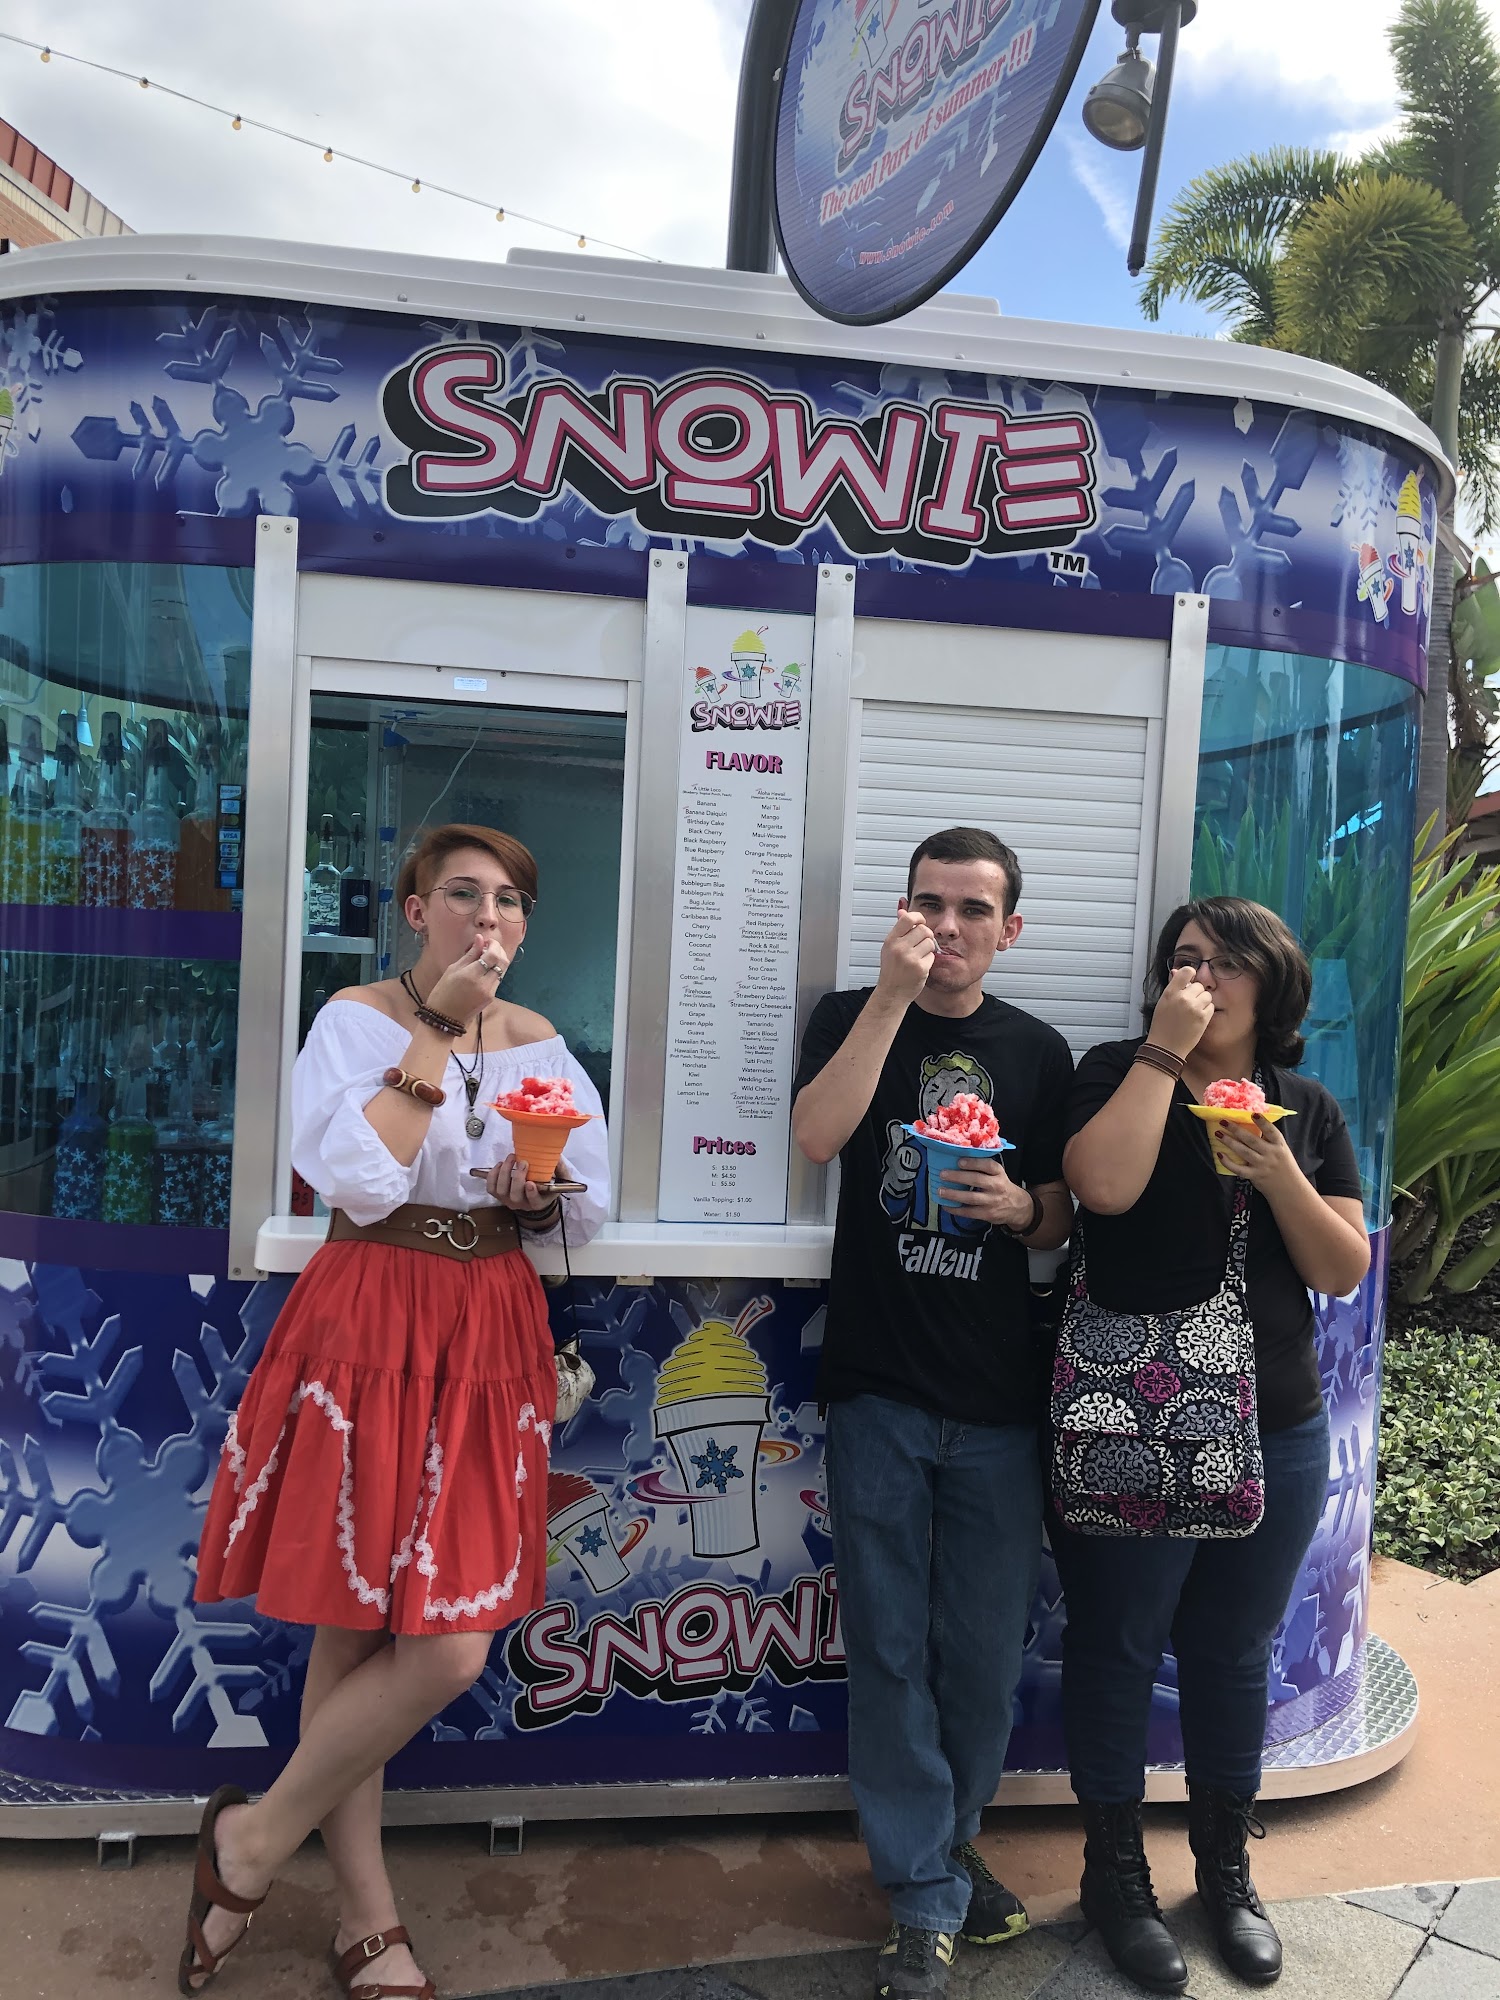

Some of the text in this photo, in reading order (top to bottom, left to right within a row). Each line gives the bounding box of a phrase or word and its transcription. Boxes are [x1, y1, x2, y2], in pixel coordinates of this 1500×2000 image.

[839, 0, 1010, 172] SNOWI
[820, 190, 847, 222] The
[848, 161, 878, 205] cool
[879, 130, 914, 182] Part
[914, 107, 936, 151] of
[933, 52, 1008, 131] summer
[385, 341, 1098, 564] SNOWIE
[691, 700, 802, 732] SNOWIE
[706, 751, 783, 774] FLAVOR
[700, 838, 727, 846] Raspberry
[758, 842, 780, 850] Orange
[744, 850, 766, 858] Orange
[754, 878, 780, 886] Pineapple
[694, 1136, 756, 1156] Prices
[897, 1233, 983, 1282] Fallout
